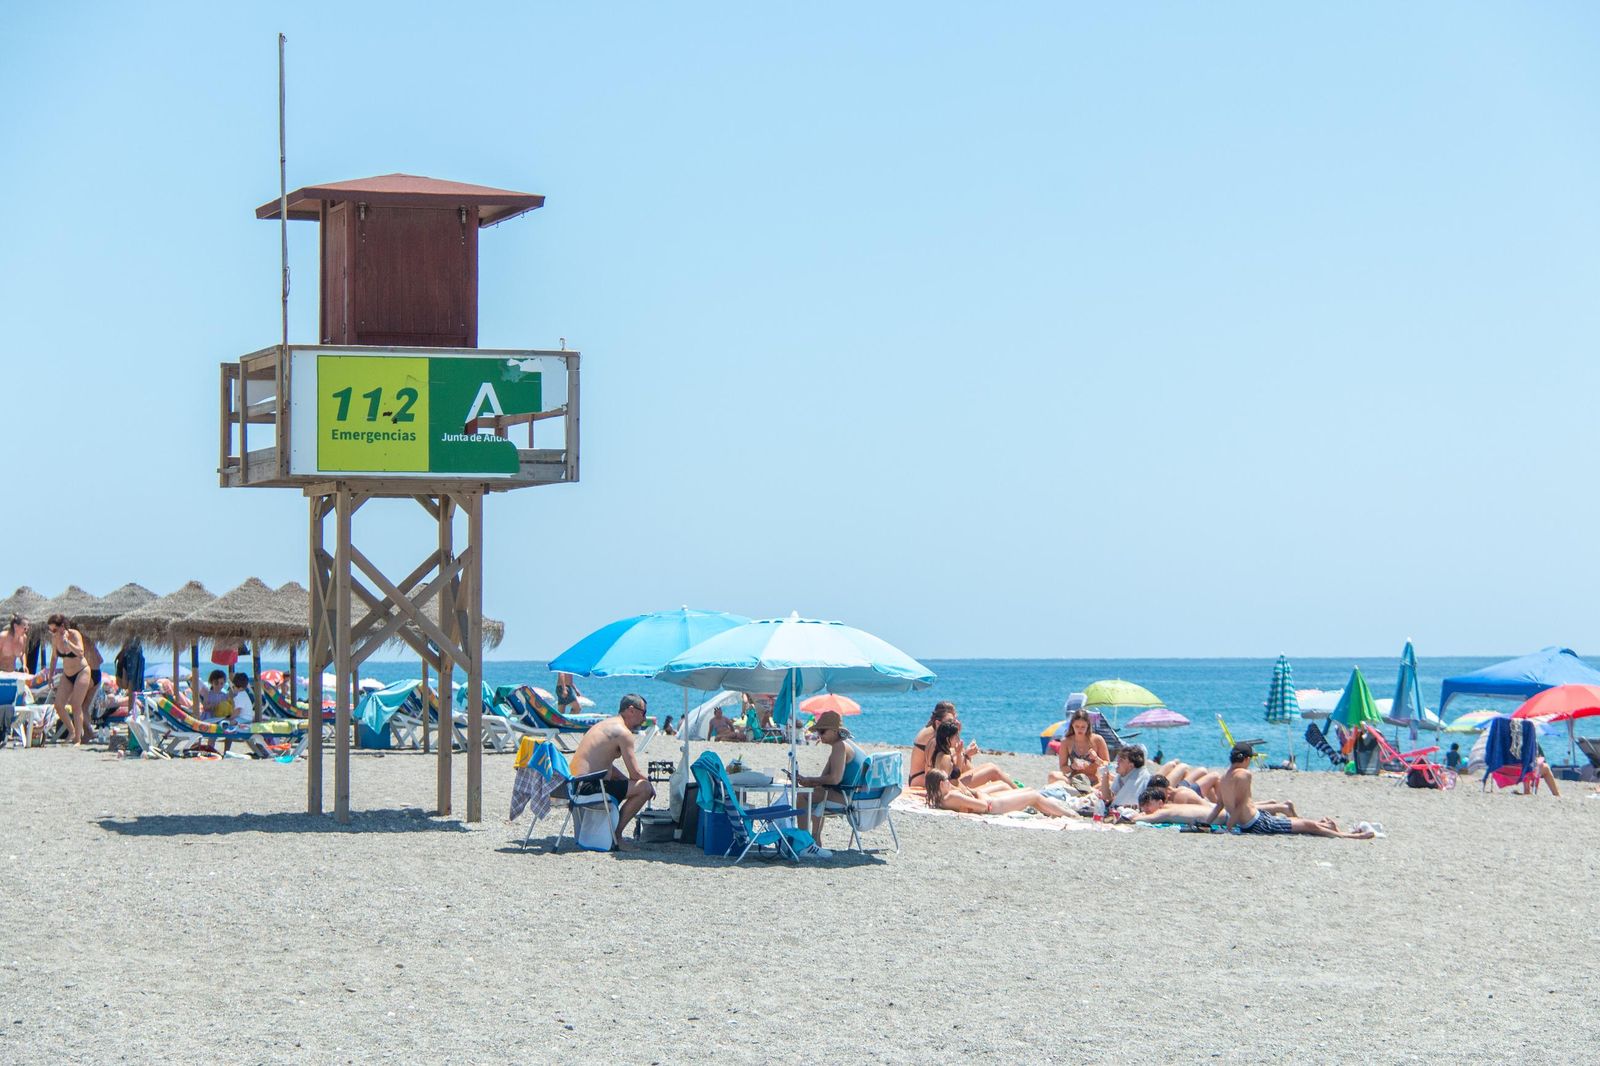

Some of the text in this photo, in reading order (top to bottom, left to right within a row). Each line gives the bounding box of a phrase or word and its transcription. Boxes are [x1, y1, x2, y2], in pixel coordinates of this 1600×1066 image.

[332, 386, 419, 423] 112
[331, 428, 417, 444] Emergencias
[441, 432, 469, 442] Junta
[470, 433, 482, 442] de
